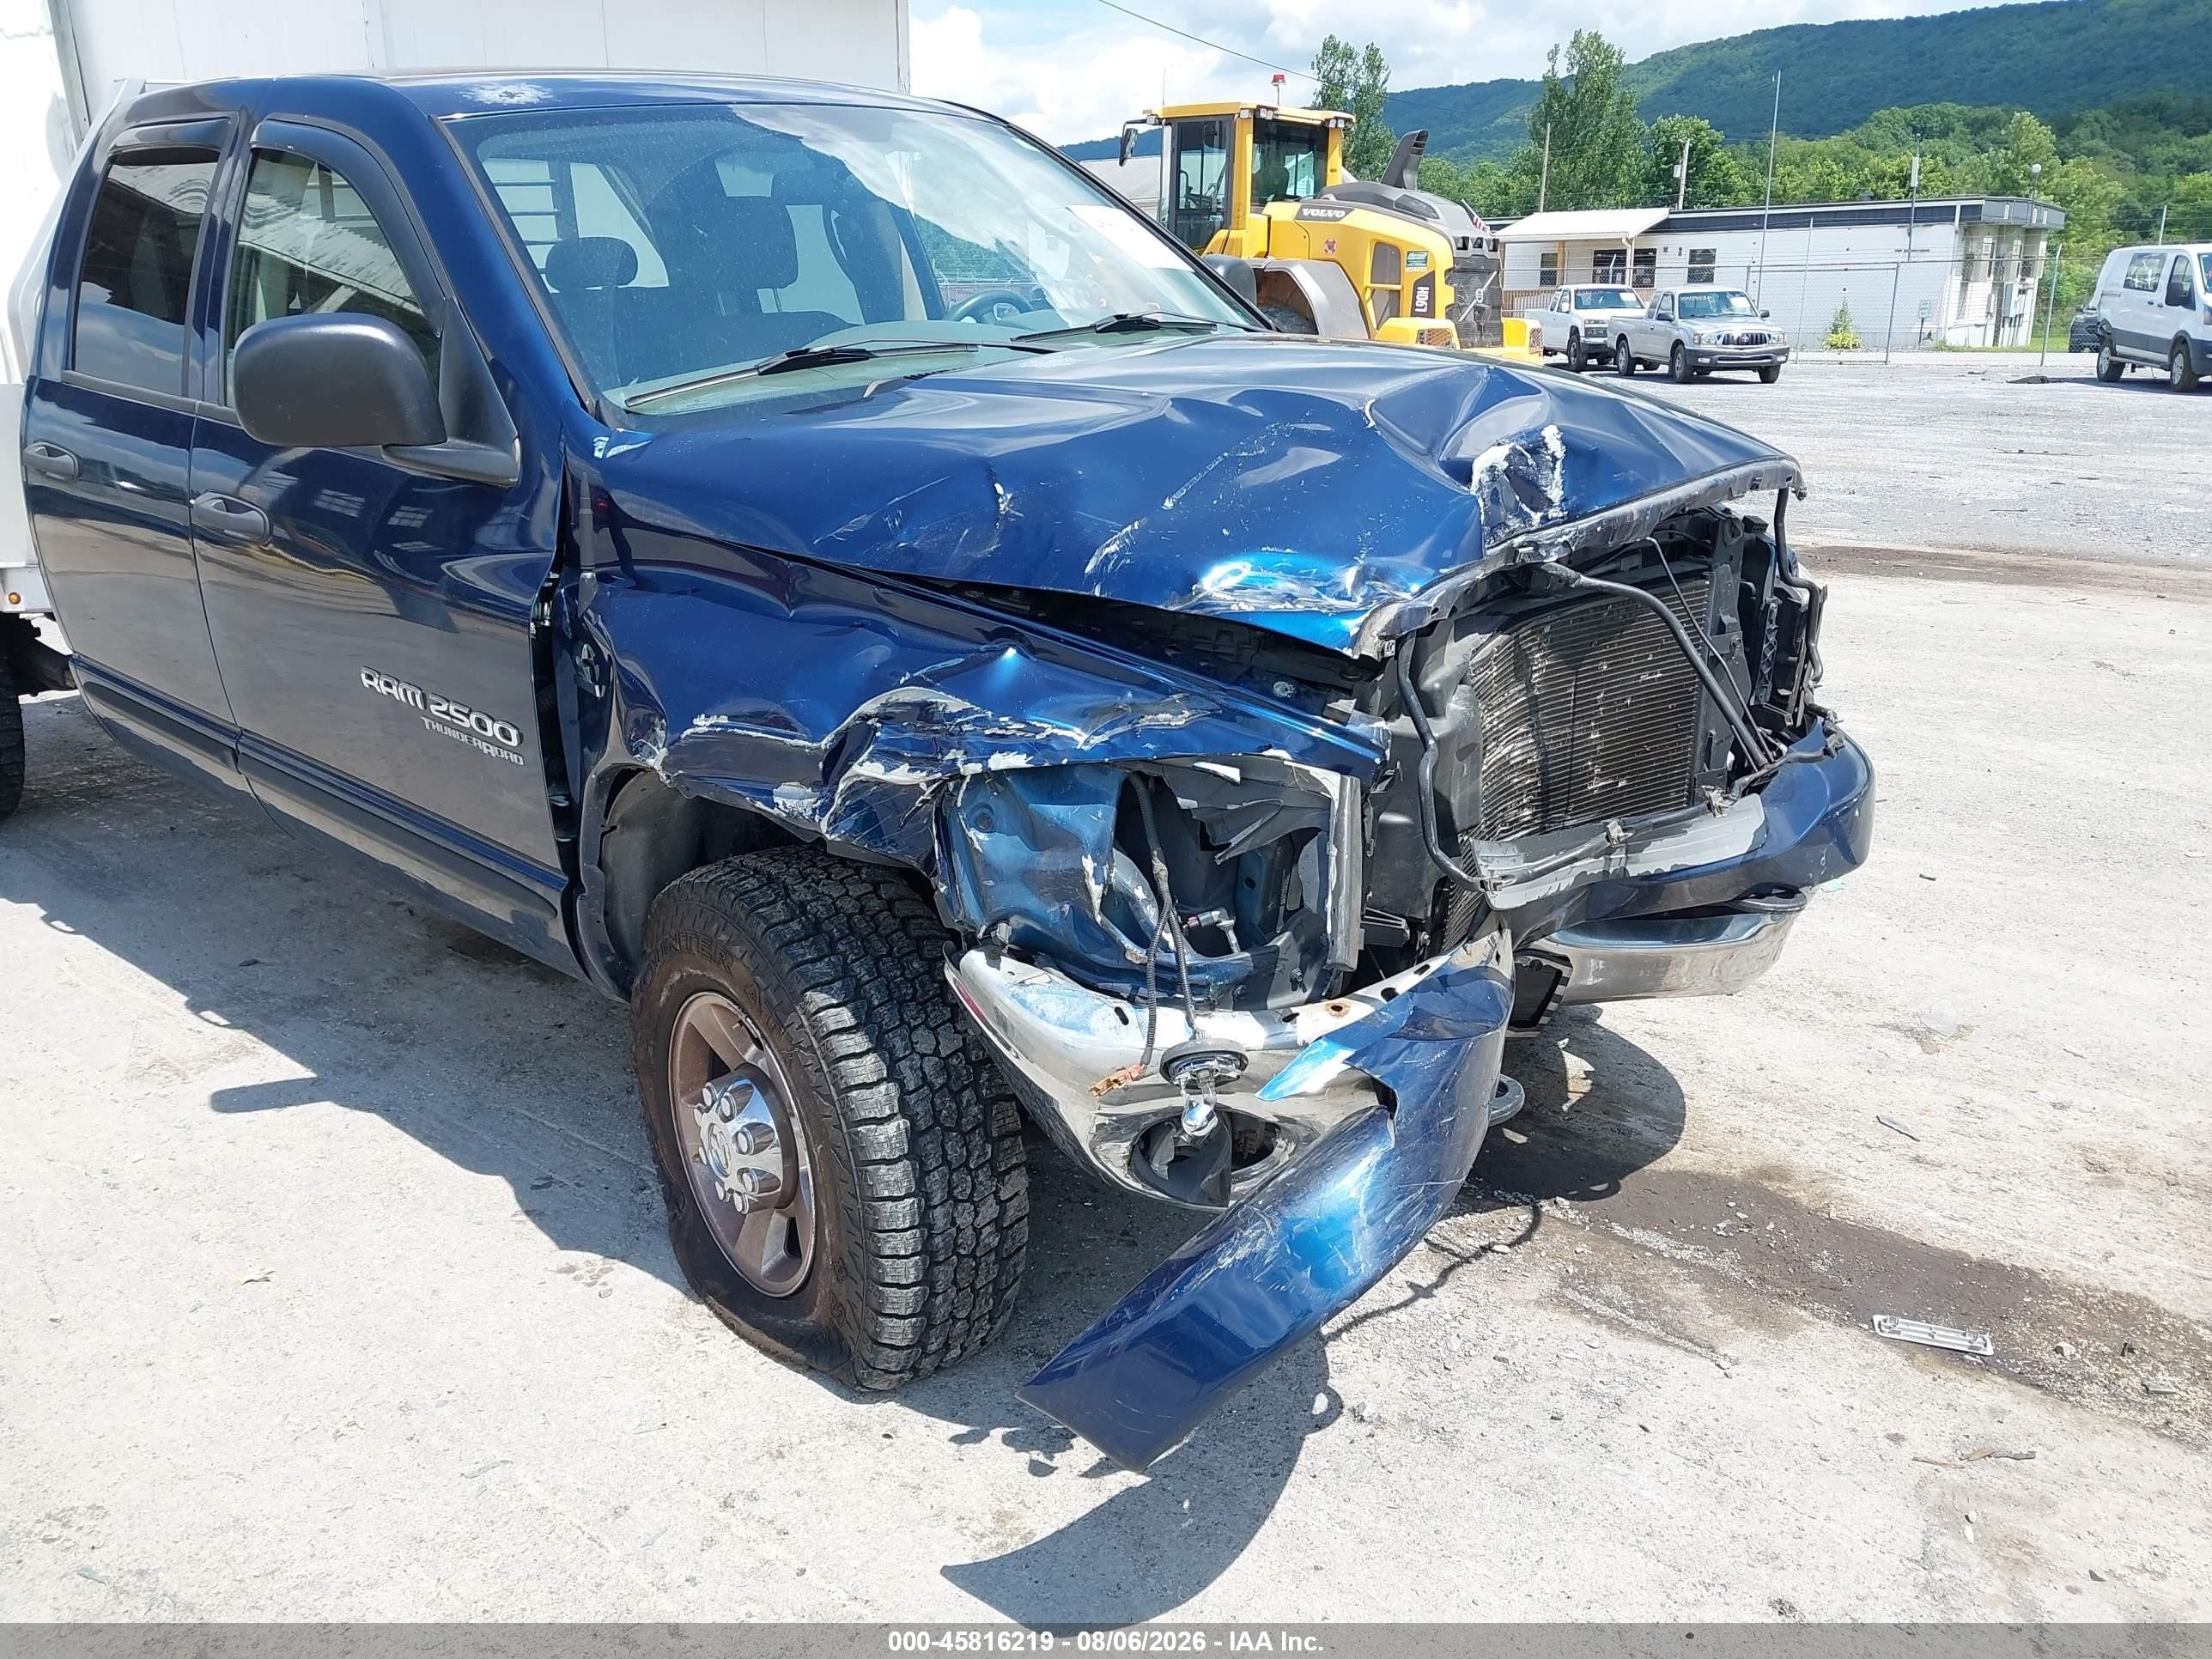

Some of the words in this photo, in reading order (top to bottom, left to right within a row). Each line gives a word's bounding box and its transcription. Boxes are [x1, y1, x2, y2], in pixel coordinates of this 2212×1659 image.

[1302, 209, 1346, 218] VOLVO
[1414, 286, 1430, 313] L90H
[360, 665, 428, 711] RAM
[428, 693, 523, 747] 2500
